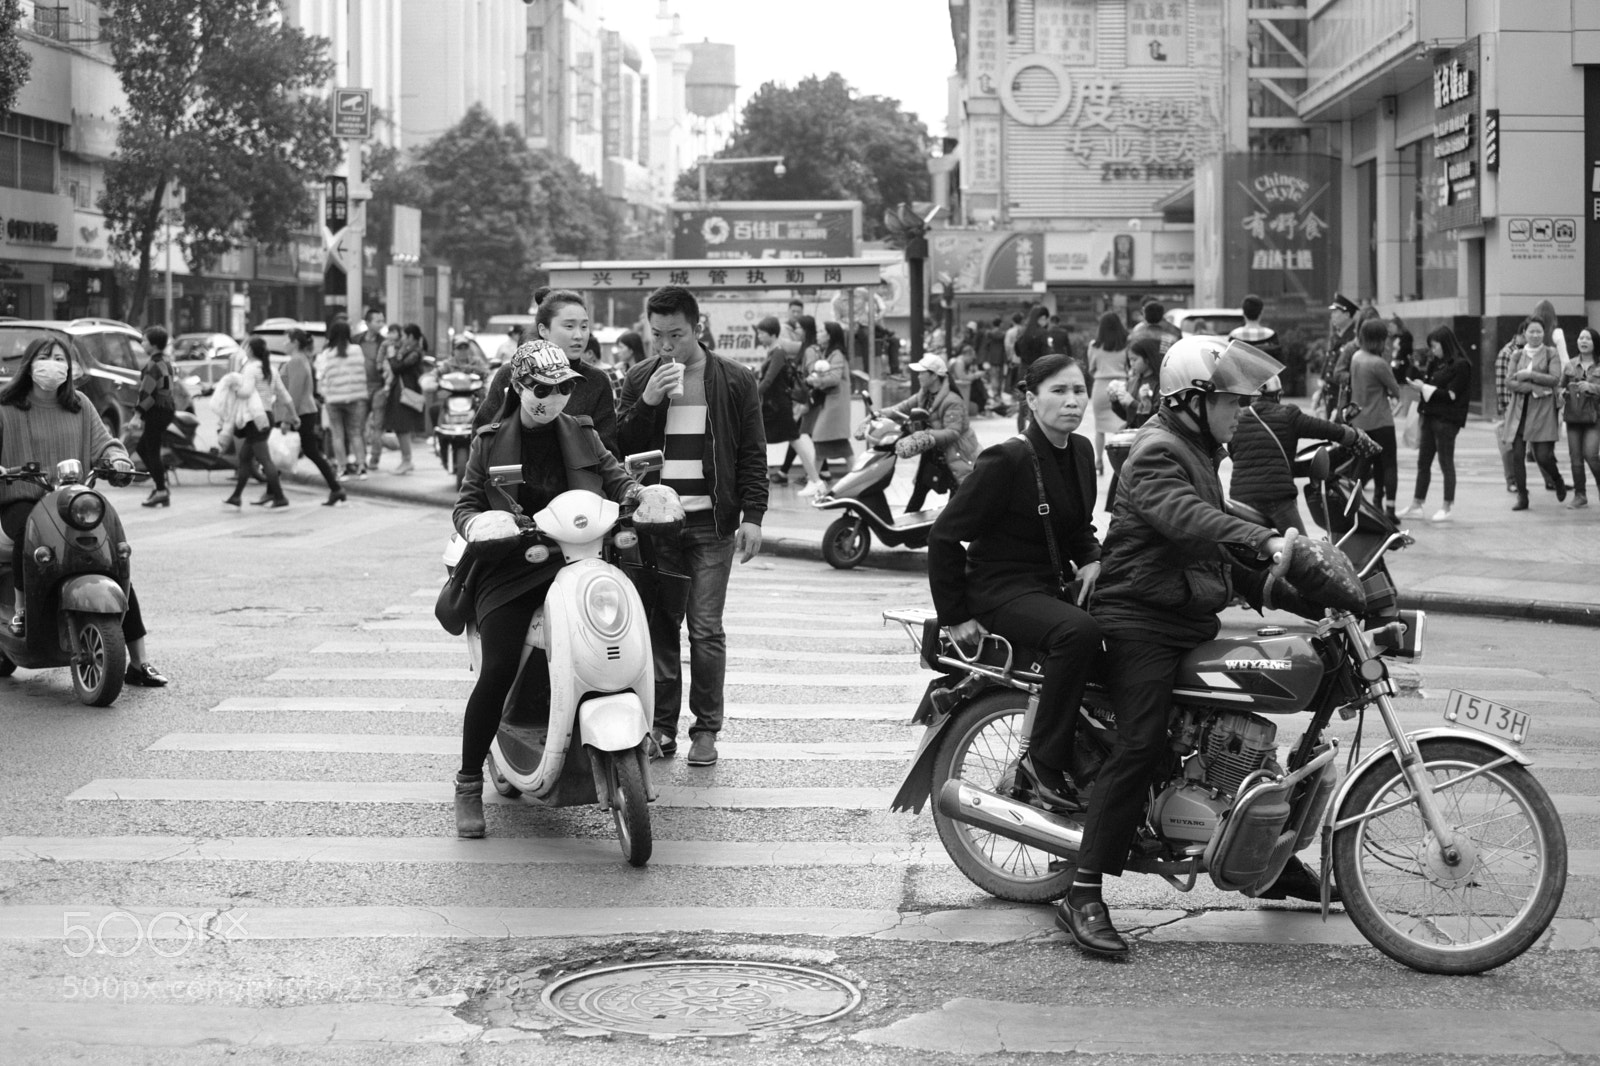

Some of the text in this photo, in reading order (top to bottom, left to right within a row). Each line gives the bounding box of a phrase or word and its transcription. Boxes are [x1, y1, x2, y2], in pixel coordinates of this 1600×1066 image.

[1254, 172, 1310, 192] Chinese
[1265, 186, 1303, 202] style
[592, 268, 843, 286] 兴宁城管执勤岗
[1225, 659, 1293, 671] WUYANG
[1453, 694, 1527, 736] 1513H
[1169, 818, 1206, 827] WUYANG
